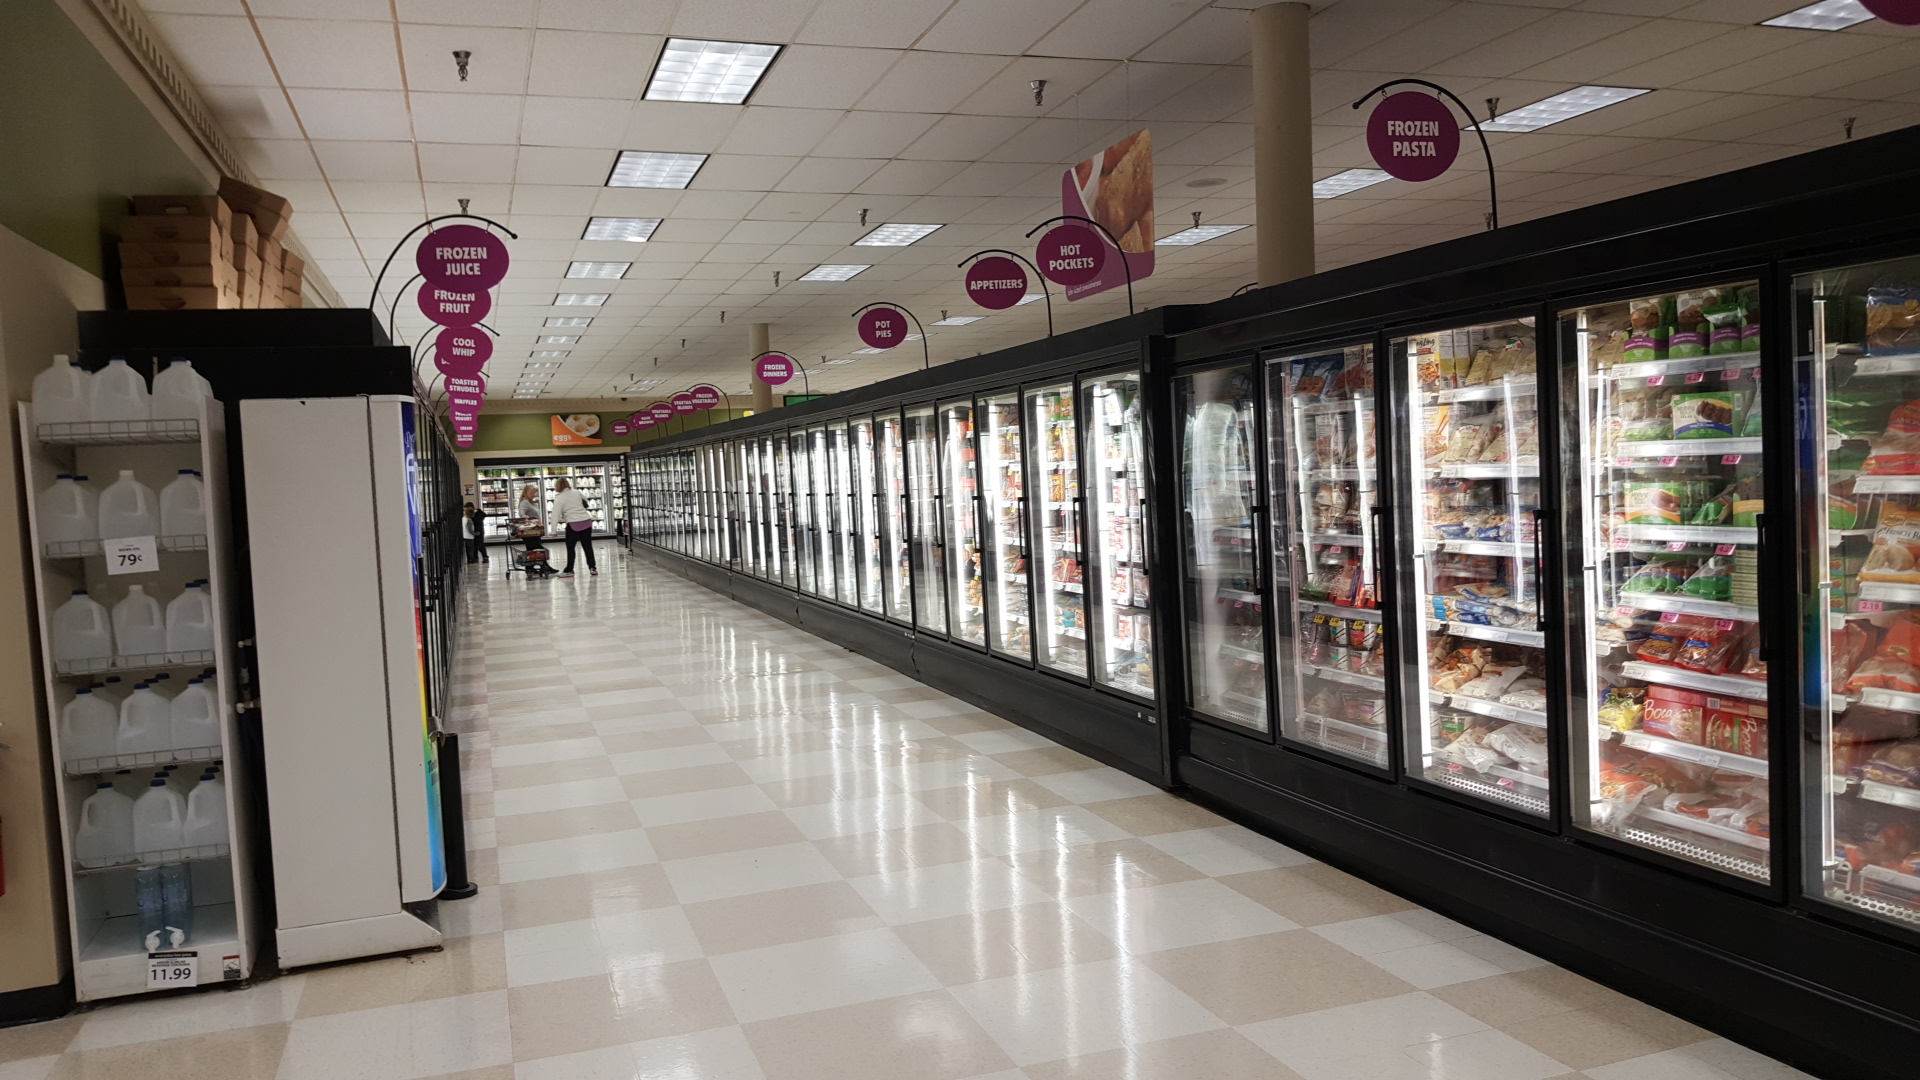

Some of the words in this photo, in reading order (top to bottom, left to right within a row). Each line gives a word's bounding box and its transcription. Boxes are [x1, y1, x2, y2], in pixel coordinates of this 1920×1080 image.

[1387, 121, 1439, 136] FROZEN
[1392, 141, 1436, 157] PASTA
[436, 247, 488, 260] FROZEN
[1060, 244, 1081, 256] HOT
[445, 263, 481, 275] JUICE
[1049, 257, 1095, 271] POCKETS
[970, 279, 1024, 291] APPETIZERS
[434, 289, 475, 301] FROZEN
[440, 302, 471, 314] FRUIT
[875, 321, 891, 329] POT
[875, 330, 892, 338] PIES
[453, 337, 476, 348] COOL
[452, 347, 476, 357] WHIP
[451, 378, 479, 387] TOASTER
[449, 385, 480, 394] STRUDELS
[454, 398, 478, 406] WAFFLES
[553, 434, 572, 442] eggs
[118, 554, 143, 567] 79¢
[1861, 602, 1880, 610] 2.19
[1644, 698, 1673, 721] Boca
[1739, 715, 1758, 756] Boca
[151, 968, 191, 981] 11.99
